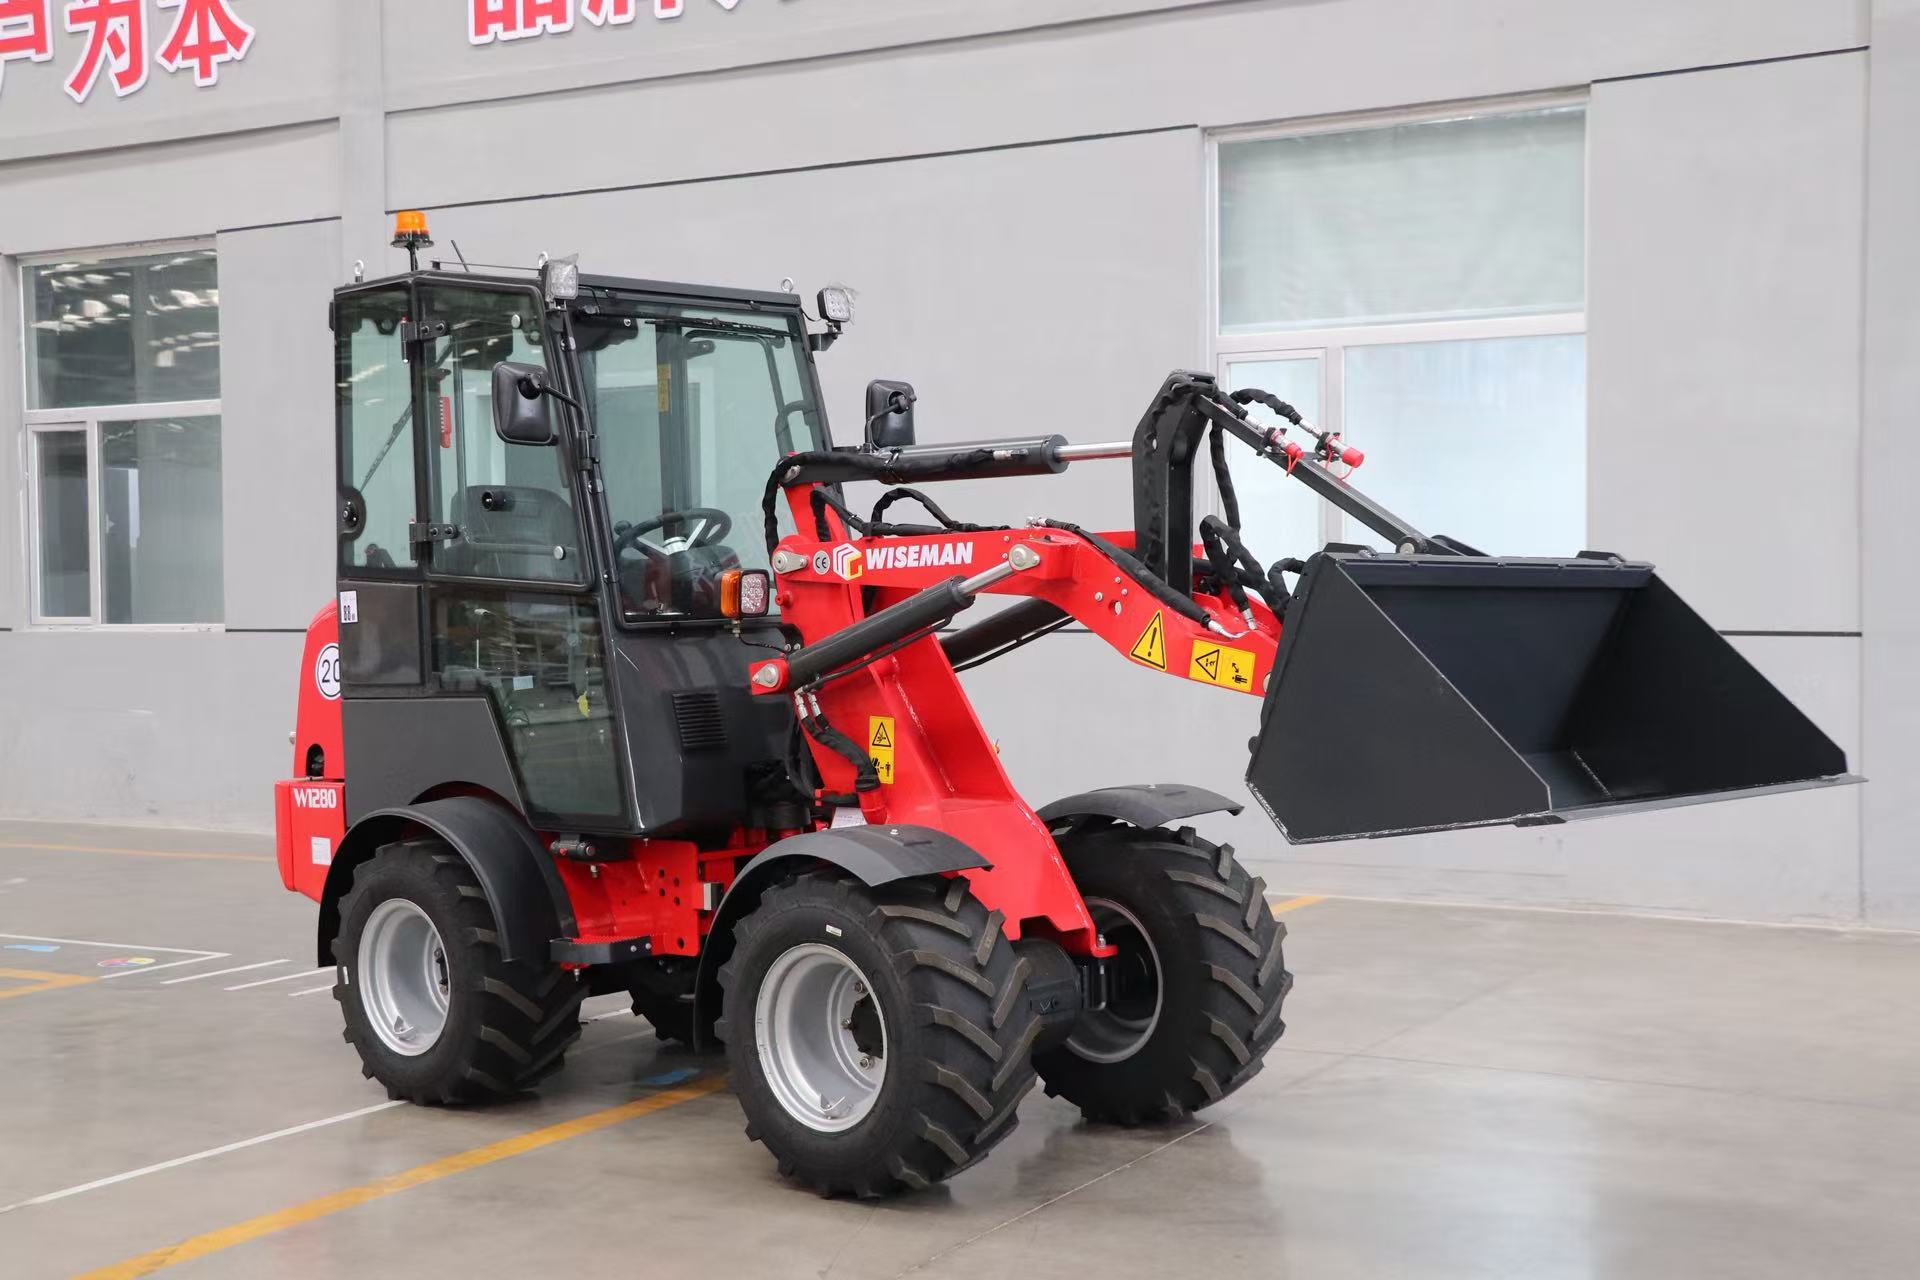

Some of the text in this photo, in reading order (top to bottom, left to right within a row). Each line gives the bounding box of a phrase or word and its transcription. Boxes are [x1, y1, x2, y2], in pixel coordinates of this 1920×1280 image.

[815, 556, 828, 570] CE
[866, 541, 973, 570] WISEMAN
[293, 788, 337, 808] W1280
